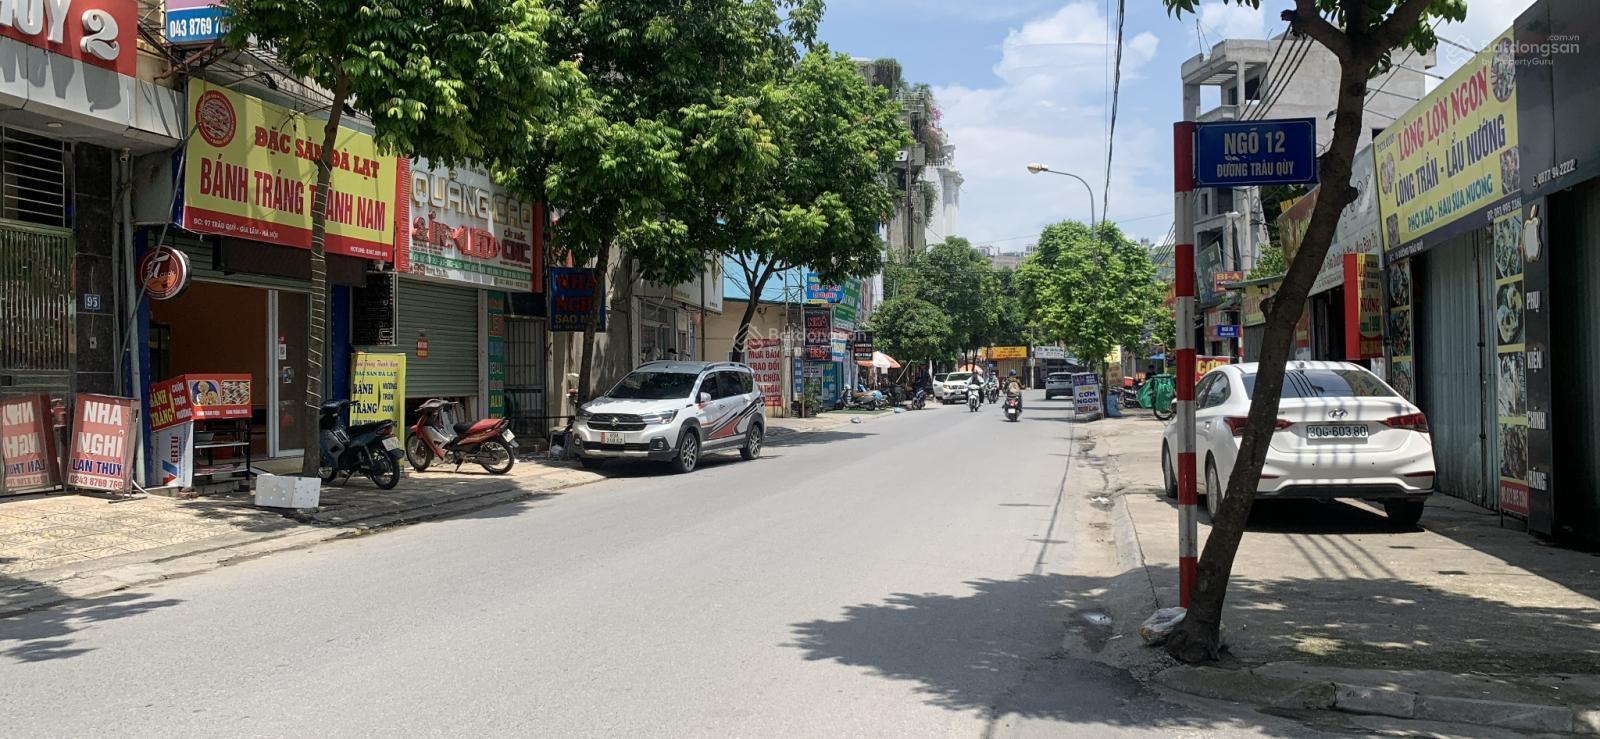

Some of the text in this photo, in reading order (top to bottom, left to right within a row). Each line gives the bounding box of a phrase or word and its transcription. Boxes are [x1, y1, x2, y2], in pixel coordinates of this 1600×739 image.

[80, 8, 119, 60] 2
[169, 20, 187, 38] 043
[189, 17, 212, 35] 8769
[1397, 119, 1424, 161] LÒNG
[1425, 96, 1448, 146] LỢN
[1450, 66, 1488, 125] NGON
[1224, 127, 1285, 155] NGÕ 12
[255, 126, 291, 155] ĐẶC
[353, 155, 380, 180] LẠT
[201, 153, 248, 204] BÁNH
[254, 169, 304, 215] TRÁNG
[357, 196, 386, 232] NAM
[412, 169, 489, 219] QUẢNG
[1395, 172, 1415, 207] LÒNG
[1216, 273, 1240, 281] BI-A
[86, 297, 98, 307] 95
[748, 349, 780, 359] MUA BÁN
[749, 362, 766, 371] TRAO
[353, 380, 373, 394] BÁNH
[83, 400, 122, 426] NHÀ
[352, 400, 377, 413] TRÁNG
[1308, 426, 1367, 437] 30G-603.80
[77, 429, 125, 457] NGHỈ
[72, 459, 93, 472] LAN
[70, 475, 88, 486] 0243
[89, 477, 108, 487] 8769
